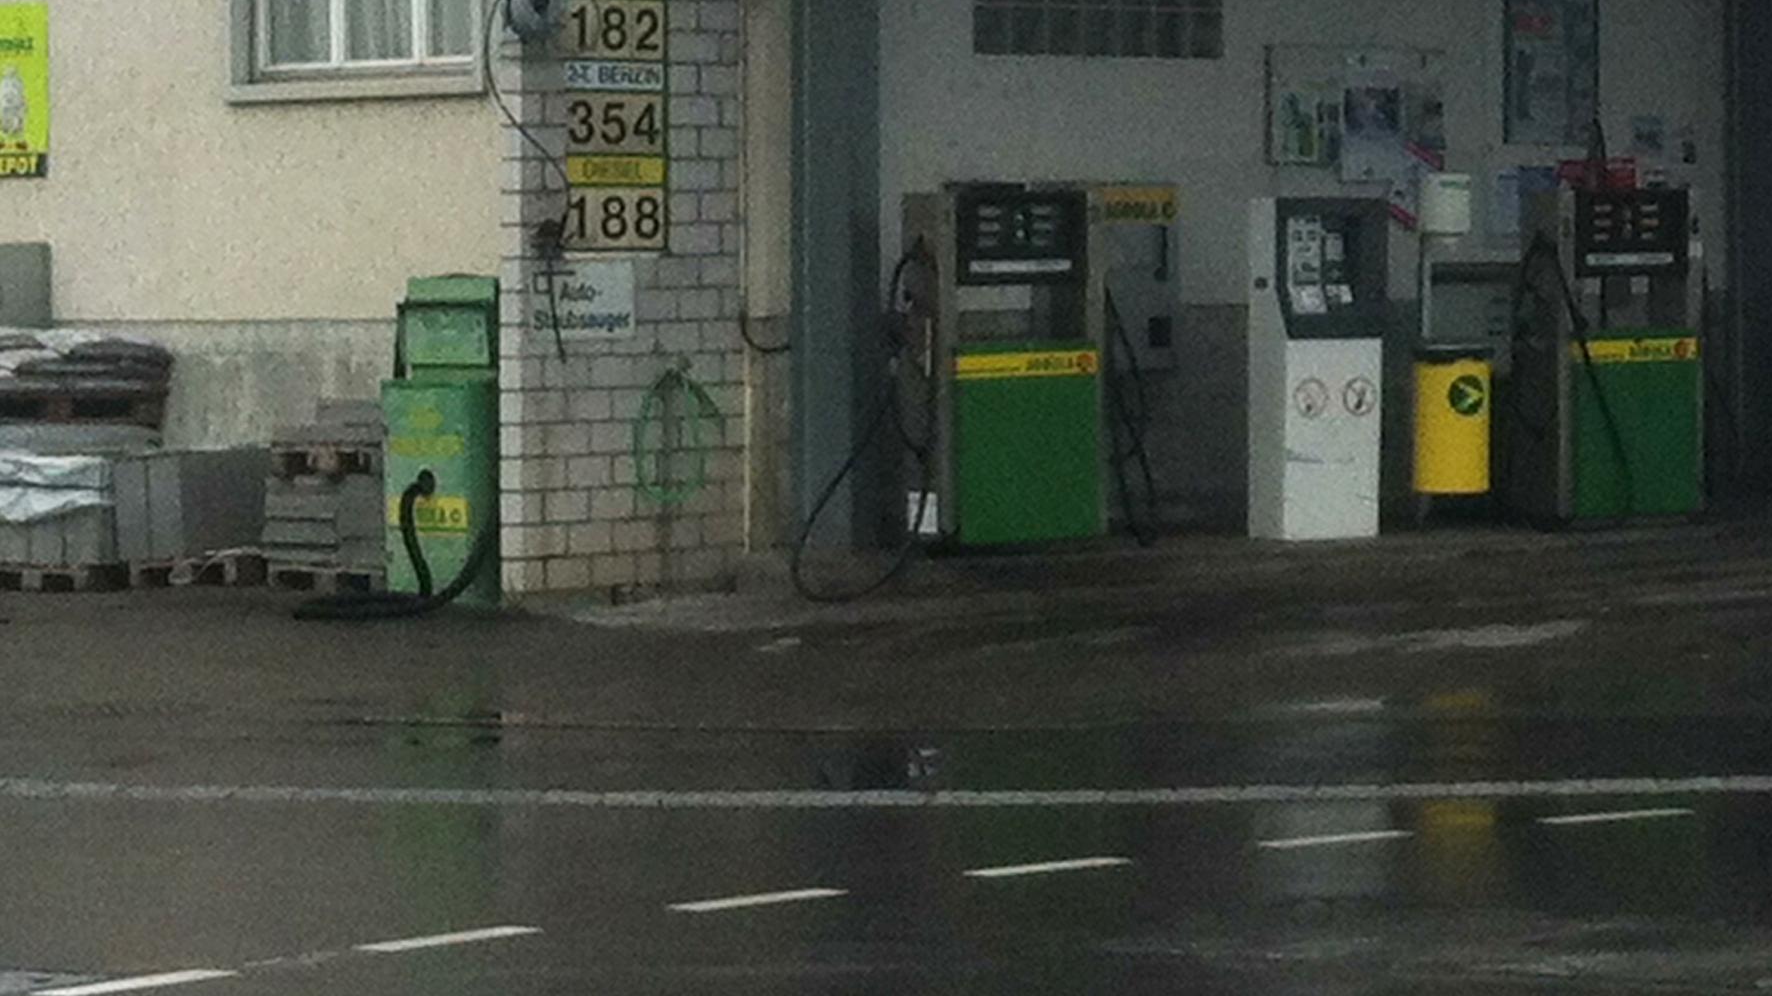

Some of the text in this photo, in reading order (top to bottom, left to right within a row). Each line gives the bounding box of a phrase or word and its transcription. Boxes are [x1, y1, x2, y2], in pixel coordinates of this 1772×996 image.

[571, 5, 660, 52] 182
[568, 100, 660, 146] 354
[569, 195, 660, 240] 188
